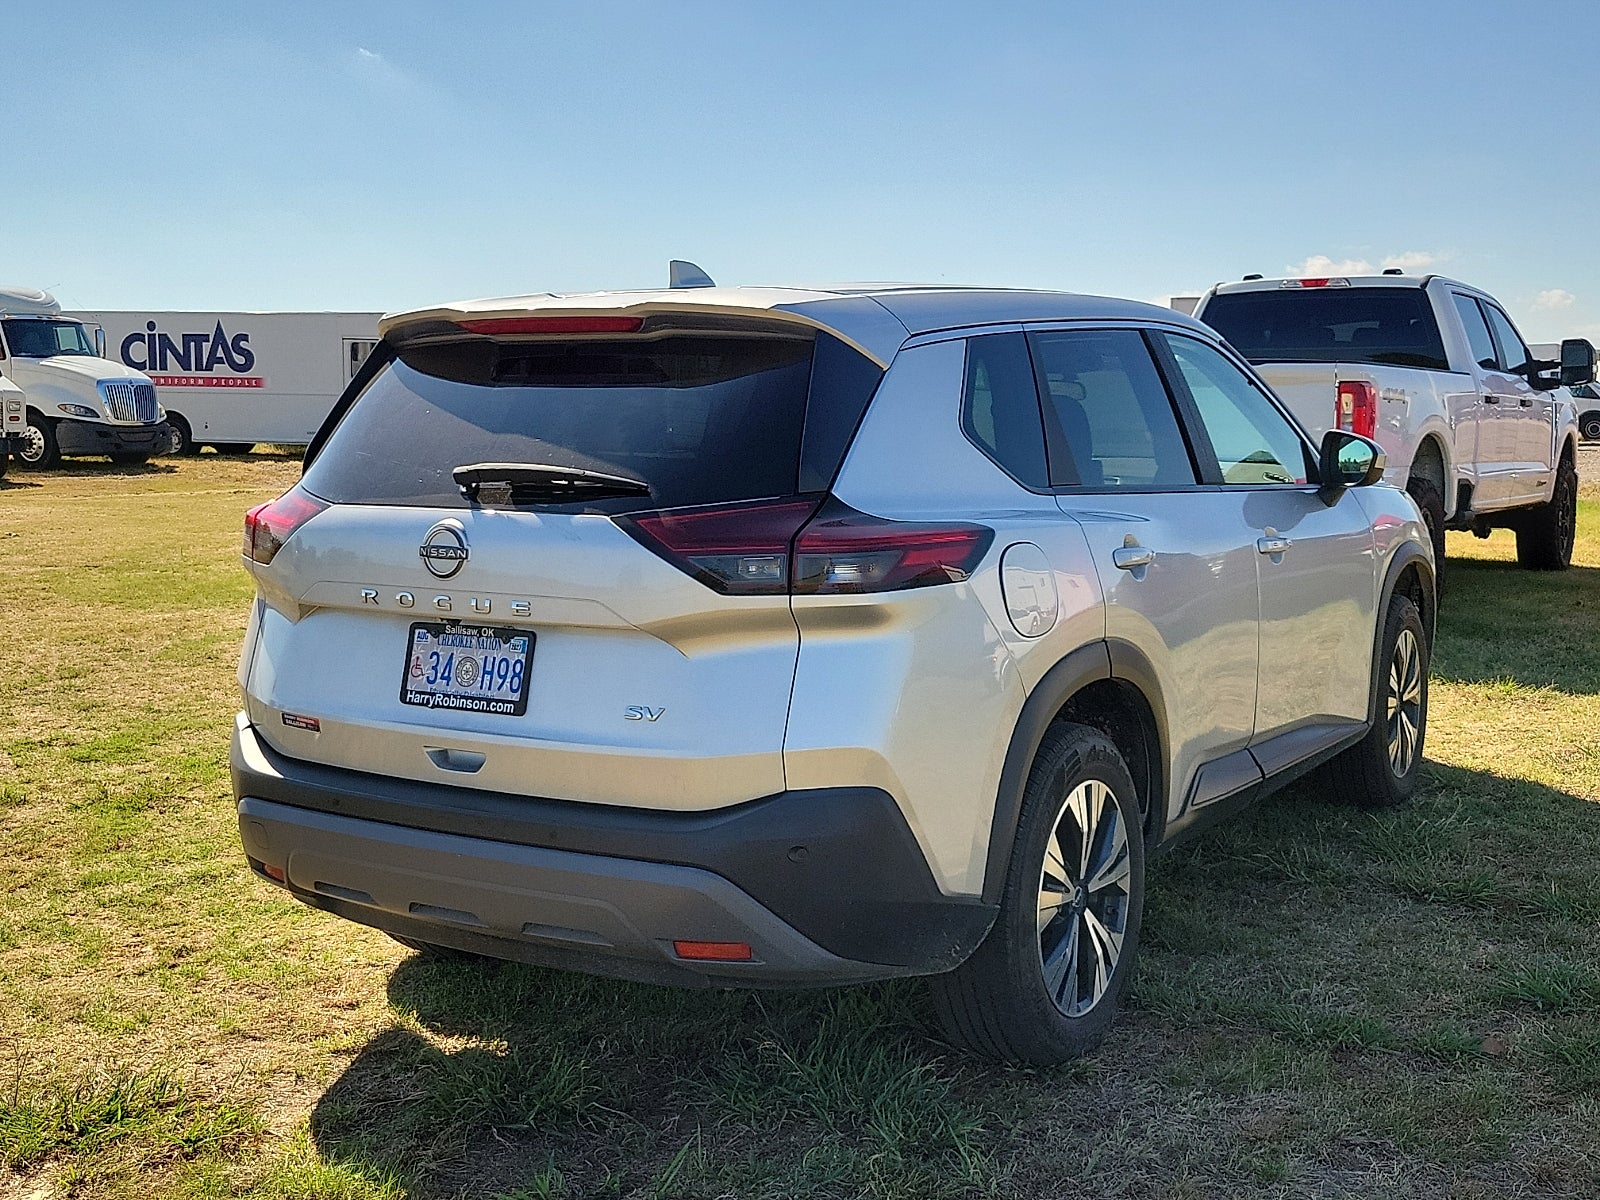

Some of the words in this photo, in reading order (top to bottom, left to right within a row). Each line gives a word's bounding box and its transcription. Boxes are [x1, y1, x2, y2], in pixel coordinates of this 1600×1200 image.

[420, 547, 467, 559] NISSAN
[361, 587, 532, 617] ROGUE
[445, 625, 480, 637] Sallisaw,
[481, 627, 495, 637] OK
[426, 651, 454, 687] 34
[479, 655, 524, 693] H98
[406, 690, 514, 713] HarryRobinson.com
[624, 704, 666, 722] SV
